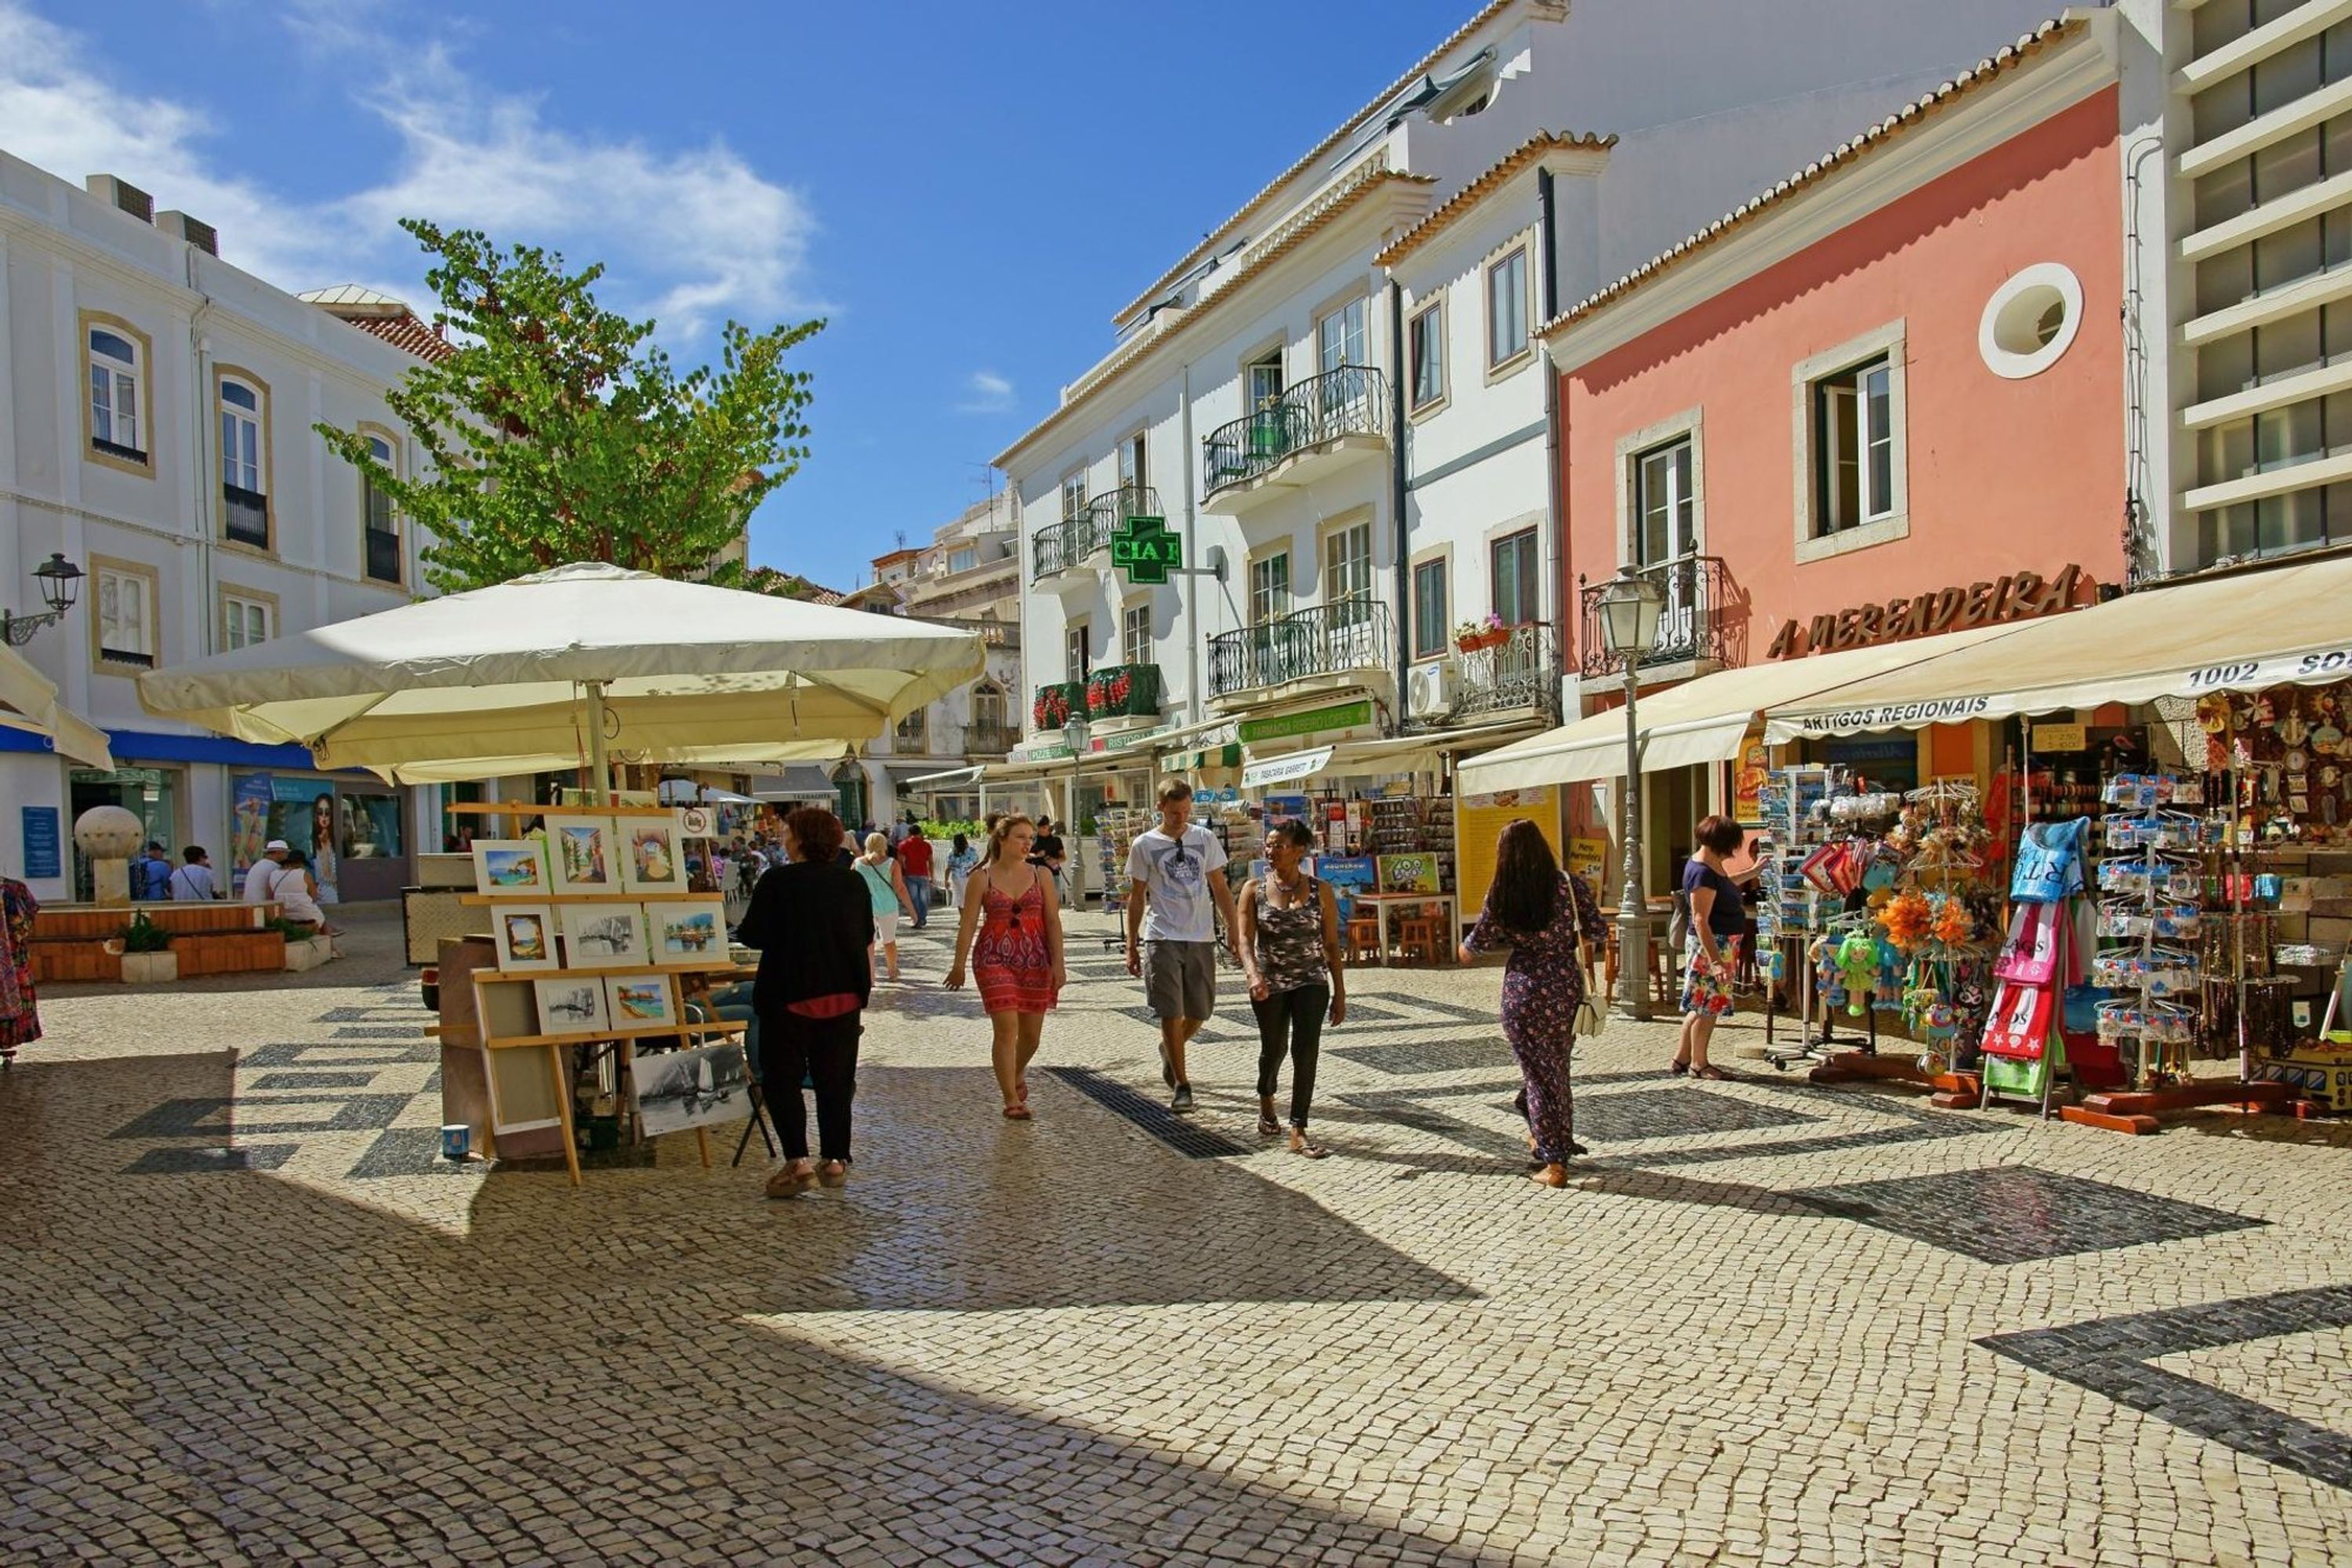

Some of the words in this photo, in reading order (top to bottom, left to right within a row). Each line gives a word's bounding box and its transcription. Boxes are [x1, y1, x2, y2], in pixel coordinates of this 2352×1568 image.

[1766, 619, 1798, 659] A
[1807, 564, 2081, 652] MERENDEIRA
[2190, 662, 2259, 688] 1002
[2298, 650, 2352, 675] SO
[1252, 722, 1292, 737] FARMACIA
[1323, 713, 1352, 728] LOPES
[1803, 709, 1875, 731] ARTIGOS
[1879, 696, 1989, 723] REGIONAIS
[1032, 747, 1062, 760] PIZZERIA
[1988, 1011, 2029, 1026] AGOS
